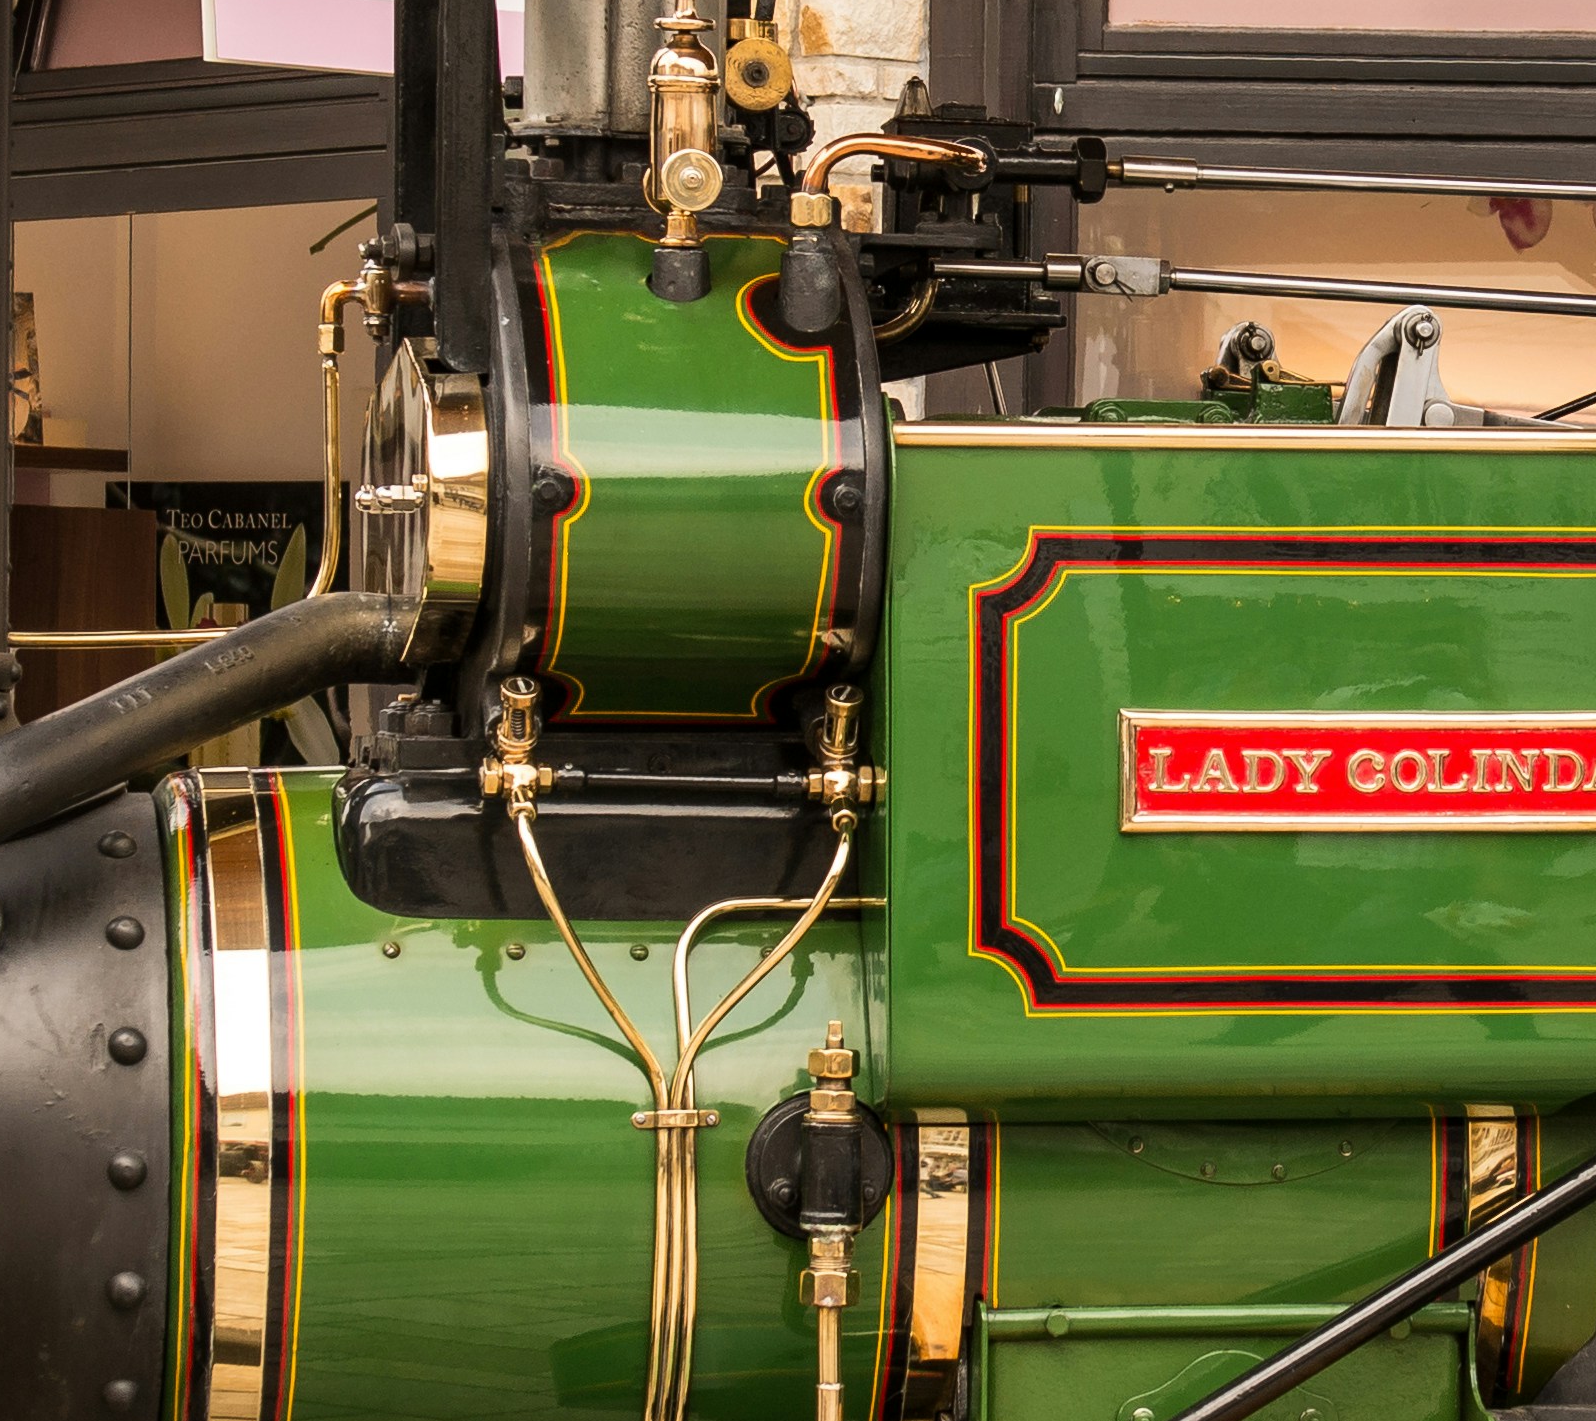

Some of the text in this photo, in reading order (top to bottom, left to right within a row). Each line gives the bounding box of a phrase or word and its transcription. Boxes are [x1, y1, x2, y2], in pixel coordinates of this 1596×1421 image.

[167, 509, 292, 529] TEO CABANEL
[178, 540, 278, 565] PARFUMS
[1148, 747, 1333, 794] LADY
